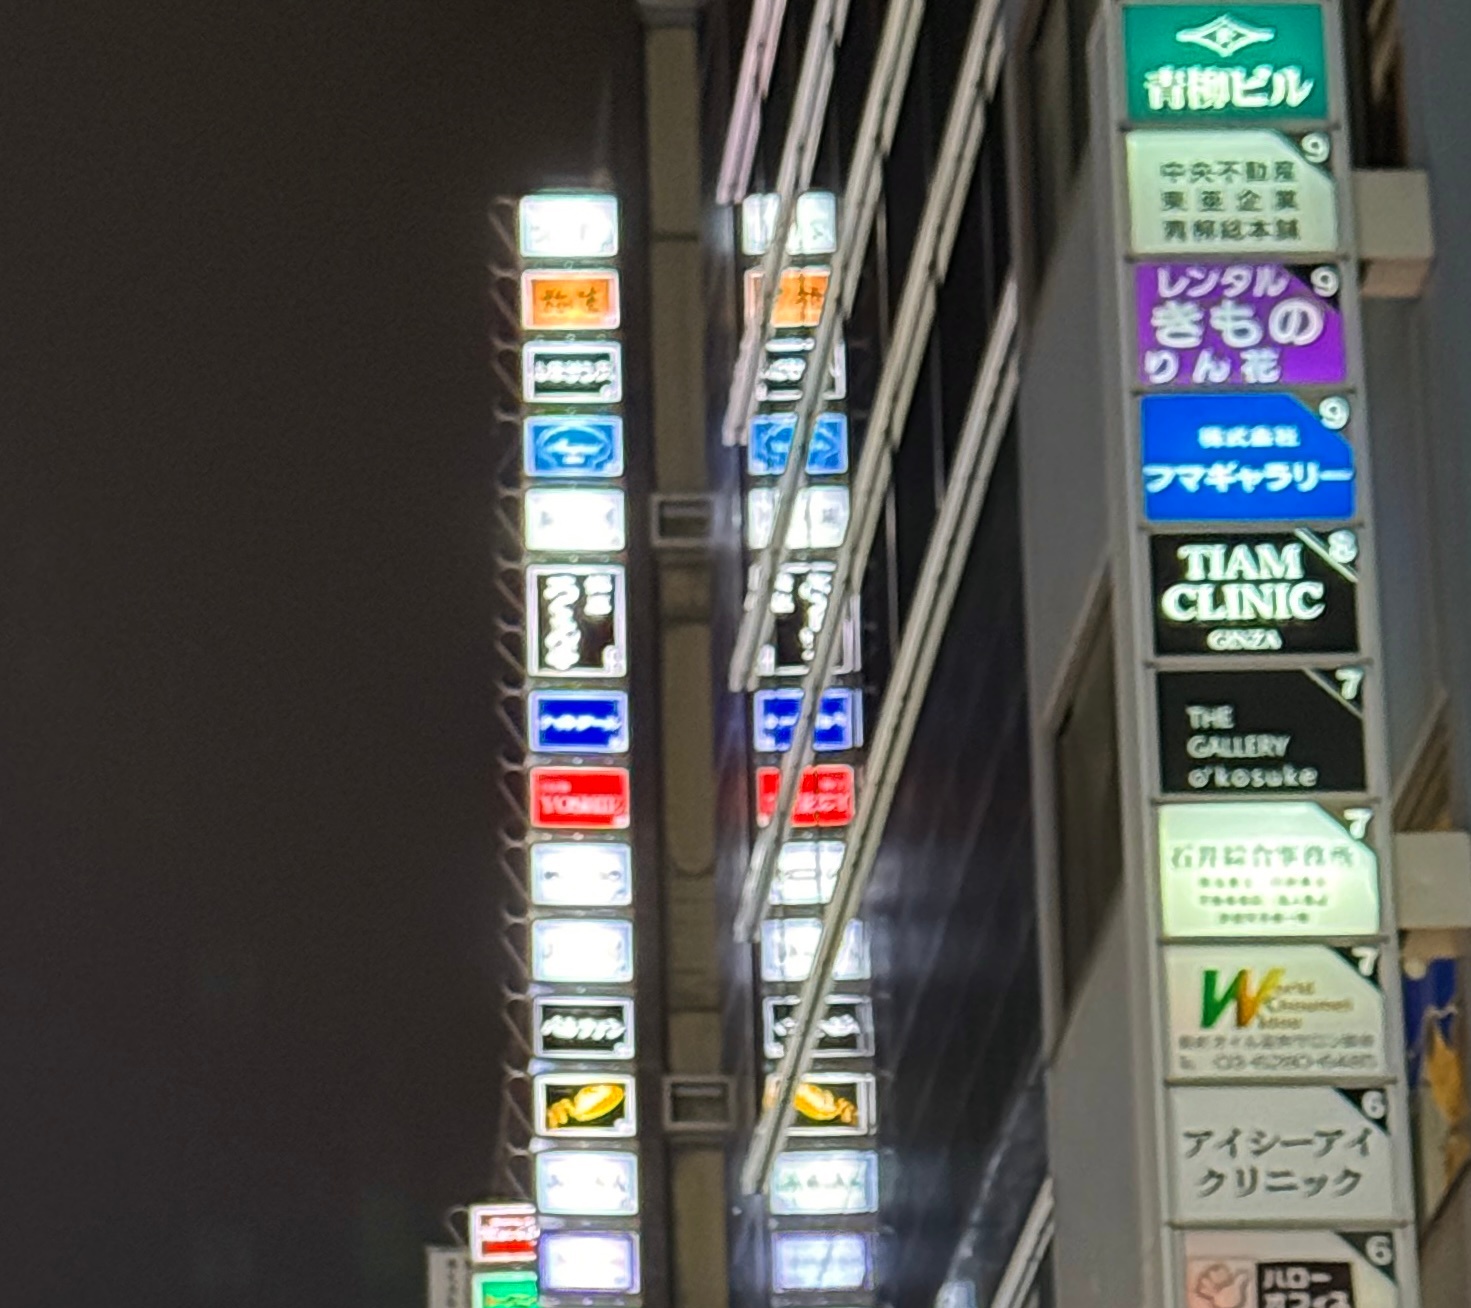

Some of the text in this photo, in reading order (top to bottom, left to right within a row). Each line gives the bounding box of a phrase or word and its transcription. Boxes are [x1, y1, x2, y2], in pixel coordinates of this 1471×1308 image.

[1145, 64, 1315, 110] 青柳ビル
[1301, 132, 1330, 164] 9
[1159, 161, 1300, 184] 中央不動産
[1156, 265, 1291, 298] レンタル
[1310, 265, 1339, 298] 9
[1150, 297, 1325, 348] きもの
[1144, 347, 1283, 385] りん花
[1318, 396, 1349, 429] 9
[1177, 542, 1305, 581] TIAM
[1161, 581, 1326, 622] CLINIC
[1206, 627, 1283, 652] GINZA
[1335, 667, 1365, 700] 7
[1185, 704, 1236, 730] THE
[1185, 734, 1292, 760] GALLERY
[1344, 807, 1374, 840] 7
[1351, 946, 1380, 977] 7
[1360, 1091, 1386, 1120] 6
[1183, 1127, 1373, 1160] アイシーアイ
[1197, 1165, 1363, 1199] クリニック
[1365, 1235, 1392, 1265] 6
[1263, 1266, 1333, 1290] ハロー
